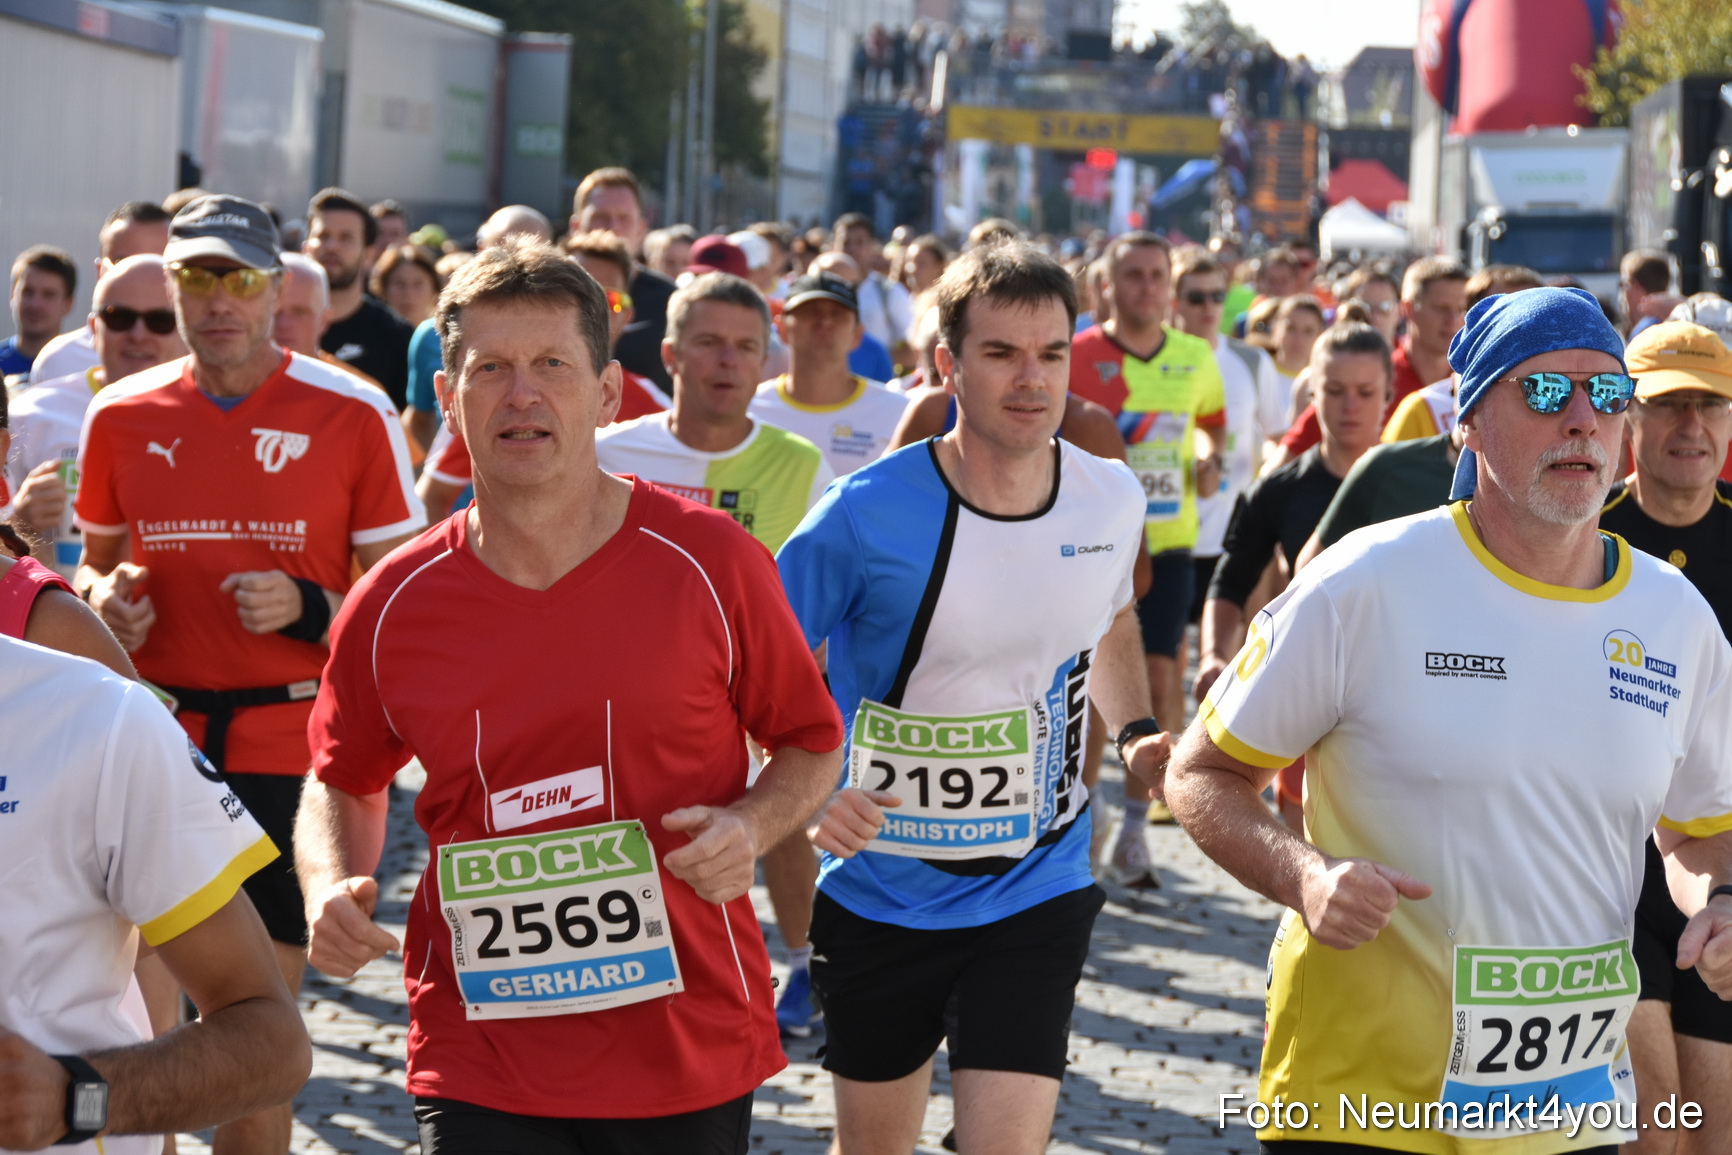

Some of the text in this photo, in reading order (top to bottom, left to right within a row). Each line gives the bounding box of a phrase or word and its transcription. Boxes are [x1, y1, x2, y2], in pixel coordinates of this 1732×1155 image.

[1039, 118, 1129, 140] START
[137, 519, 227, 535] ENGELHARDT
[1426, 652, 1506, 674] BOCK
[1608, 638, 1675, 676] 20 JAHRE
[1609, 666, 1681, 700] Neumarkter
[1609, 685, 1669, 718] Stadtlauf
[865, 710, 1015, 752] BOCK
[1033, 742, 1046, 786] WATER
[1040, 687, 1066, 832] TECHNOLGY
[521, 785, 572, 814] DEHN
[869, 759, 1011, 810] 2192
[878, 818, 1014, 841] HRISTOPH
[454, 830, 632, 891] BOCK
[470, 889, 641, 960] 2569
[641, 888, 652, 899] C
[489, 961, 646, 997] GERHARD
[1473, 950, 1626, 995] BOCK
[1476, 1008, 1617, 1074] 2817
